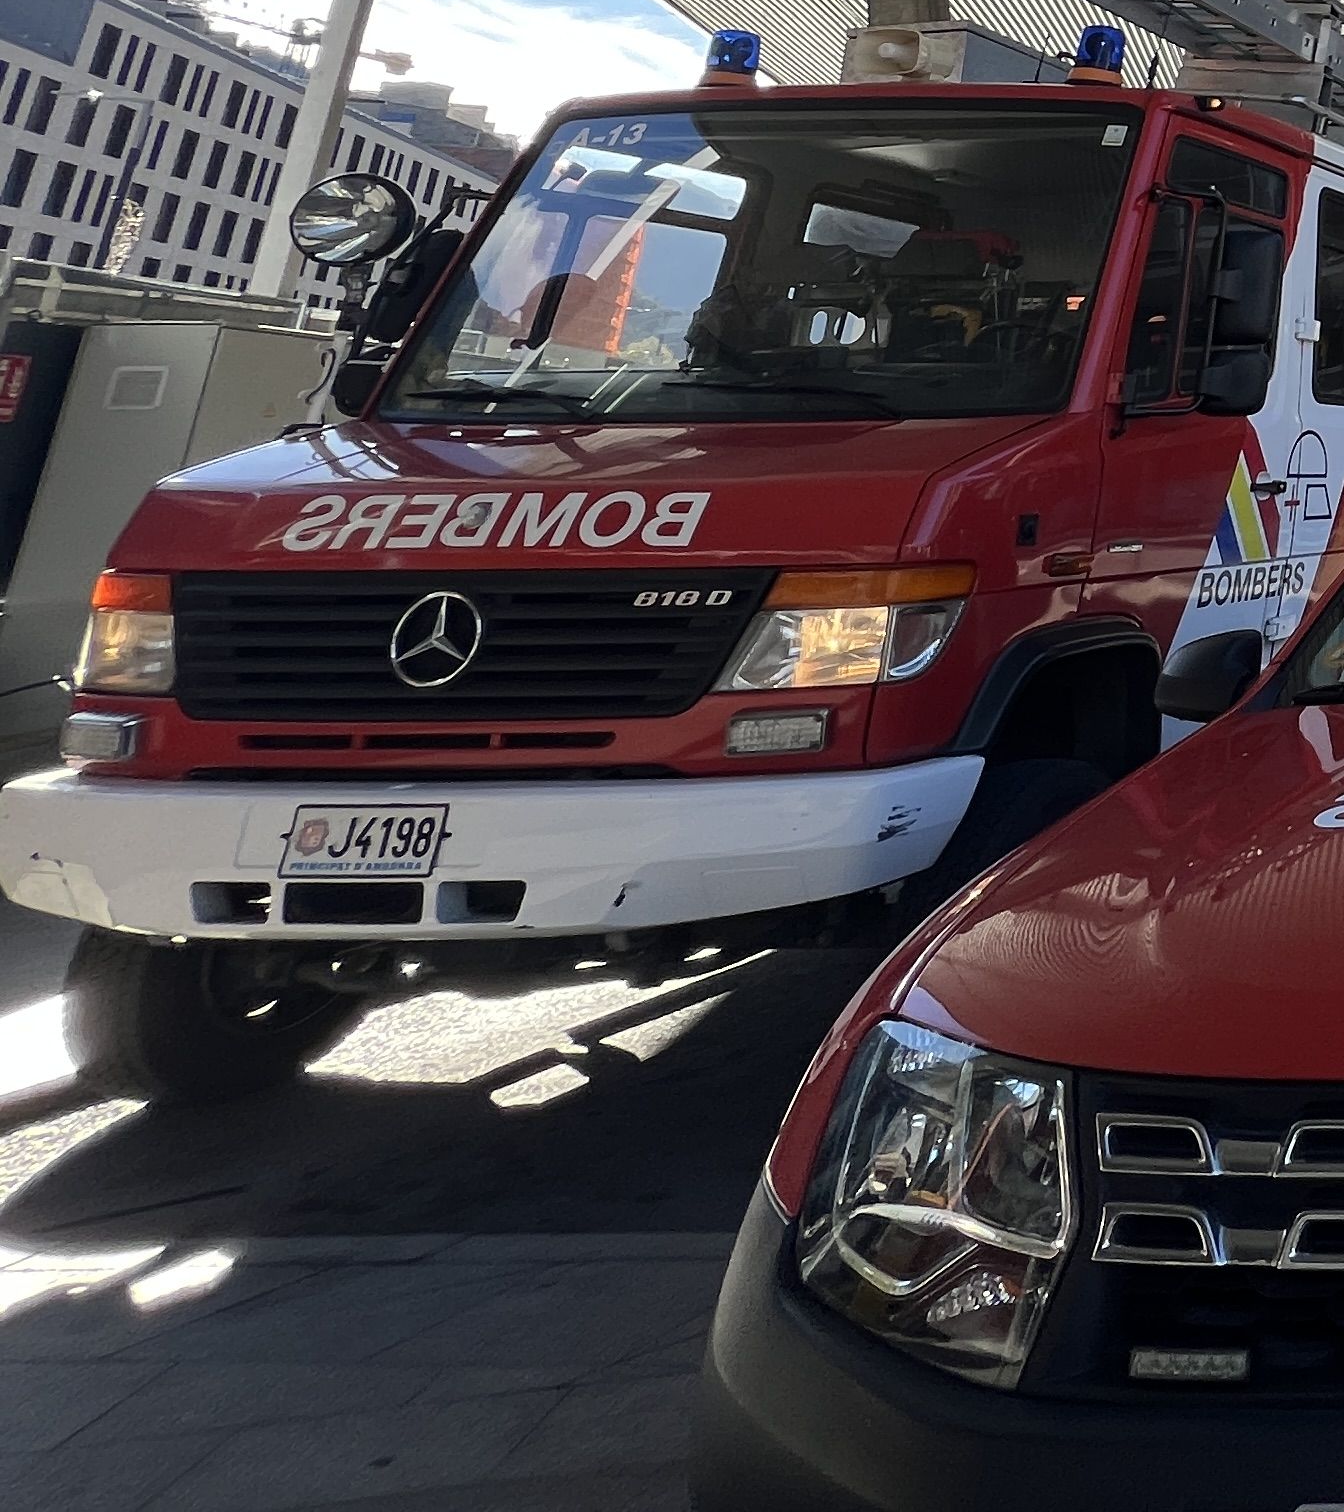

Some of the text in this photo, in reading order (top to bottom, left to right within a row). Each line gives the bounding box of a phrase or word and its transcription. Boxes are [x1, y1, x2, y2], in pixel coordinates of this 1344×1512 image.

[567, 122, 648, 147] A-13
[633, 590, 733, 607] 818 D
[1196, 561, 1305, 609] BOMBERS
[327, 816, 436, 859] J4198
